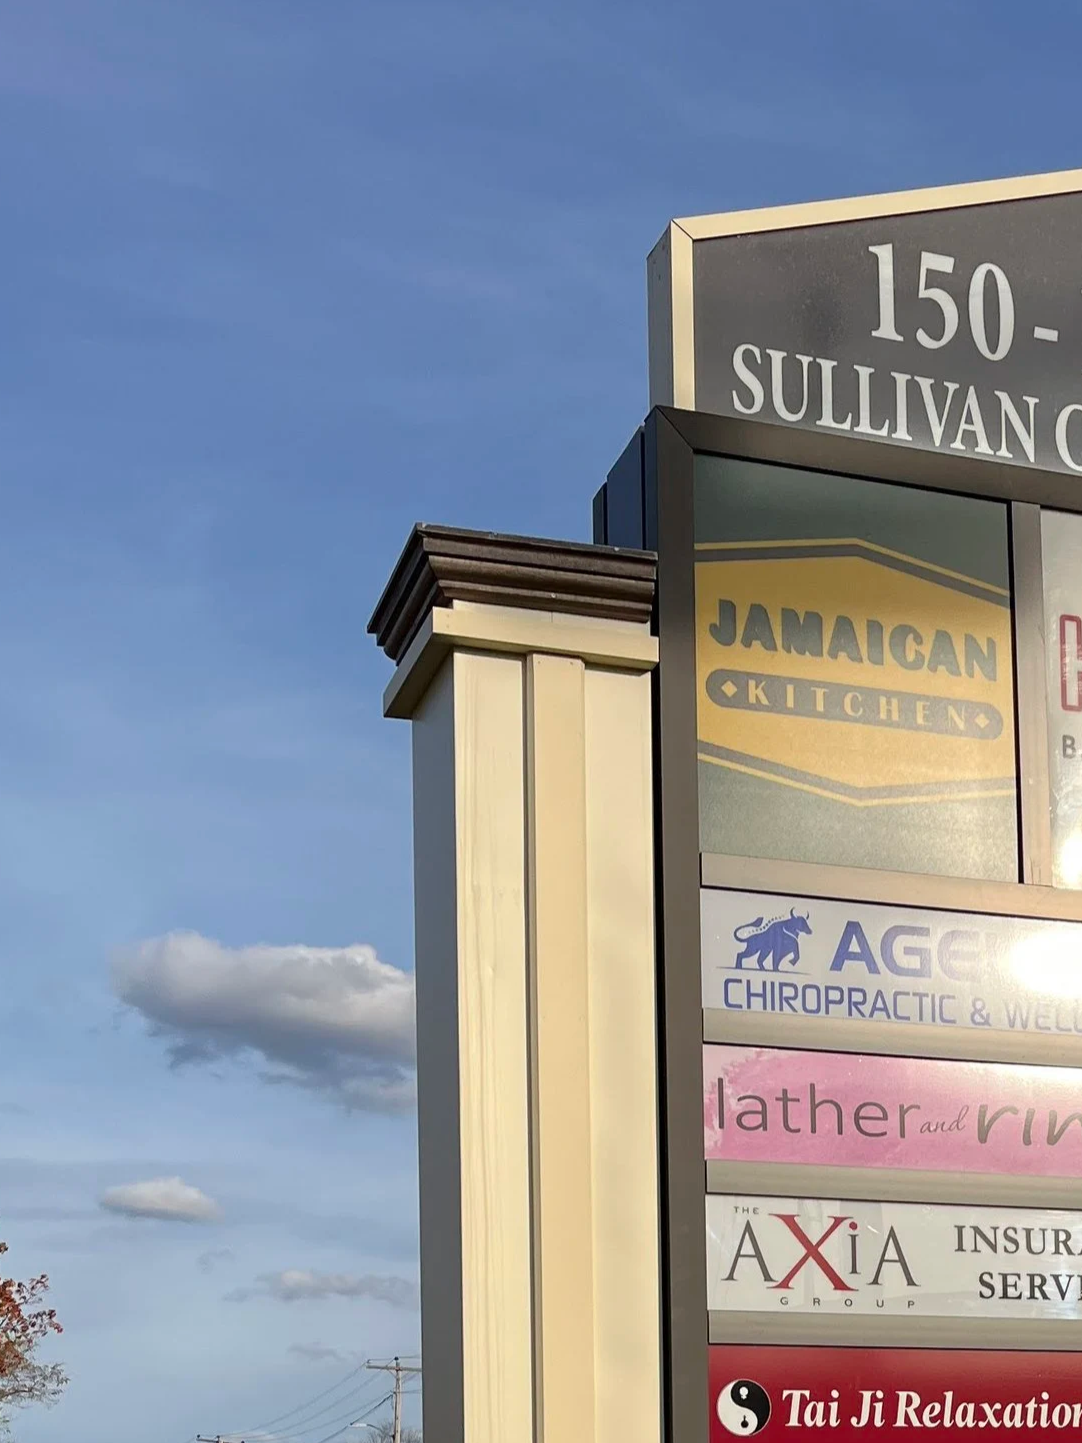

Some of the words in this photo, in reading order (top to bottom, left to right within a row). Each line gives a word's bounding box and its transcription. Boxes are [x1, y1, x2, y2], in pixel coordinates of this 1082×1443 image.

[868, 243, 1015, 361] 150
[731, 343, 1040, 463] SULLIVAN
[708, 598, 998, 682] JAMAICAN
[748, 679, 967, 732] KITCHEN
[722, 977, 958, 1026] CHIROPRACTIC
[969, 1000, 992, 1027] &
[716, 1077, 920, 1138] lather
[919, 1105, 968, 1134] and
[733, 1206, 760, 1216] THE
[779, 1295, 915, 1309] GROUP
[781, 1389, 841, 1428] Tai
[850, 1389, 886, 1428] Ji
